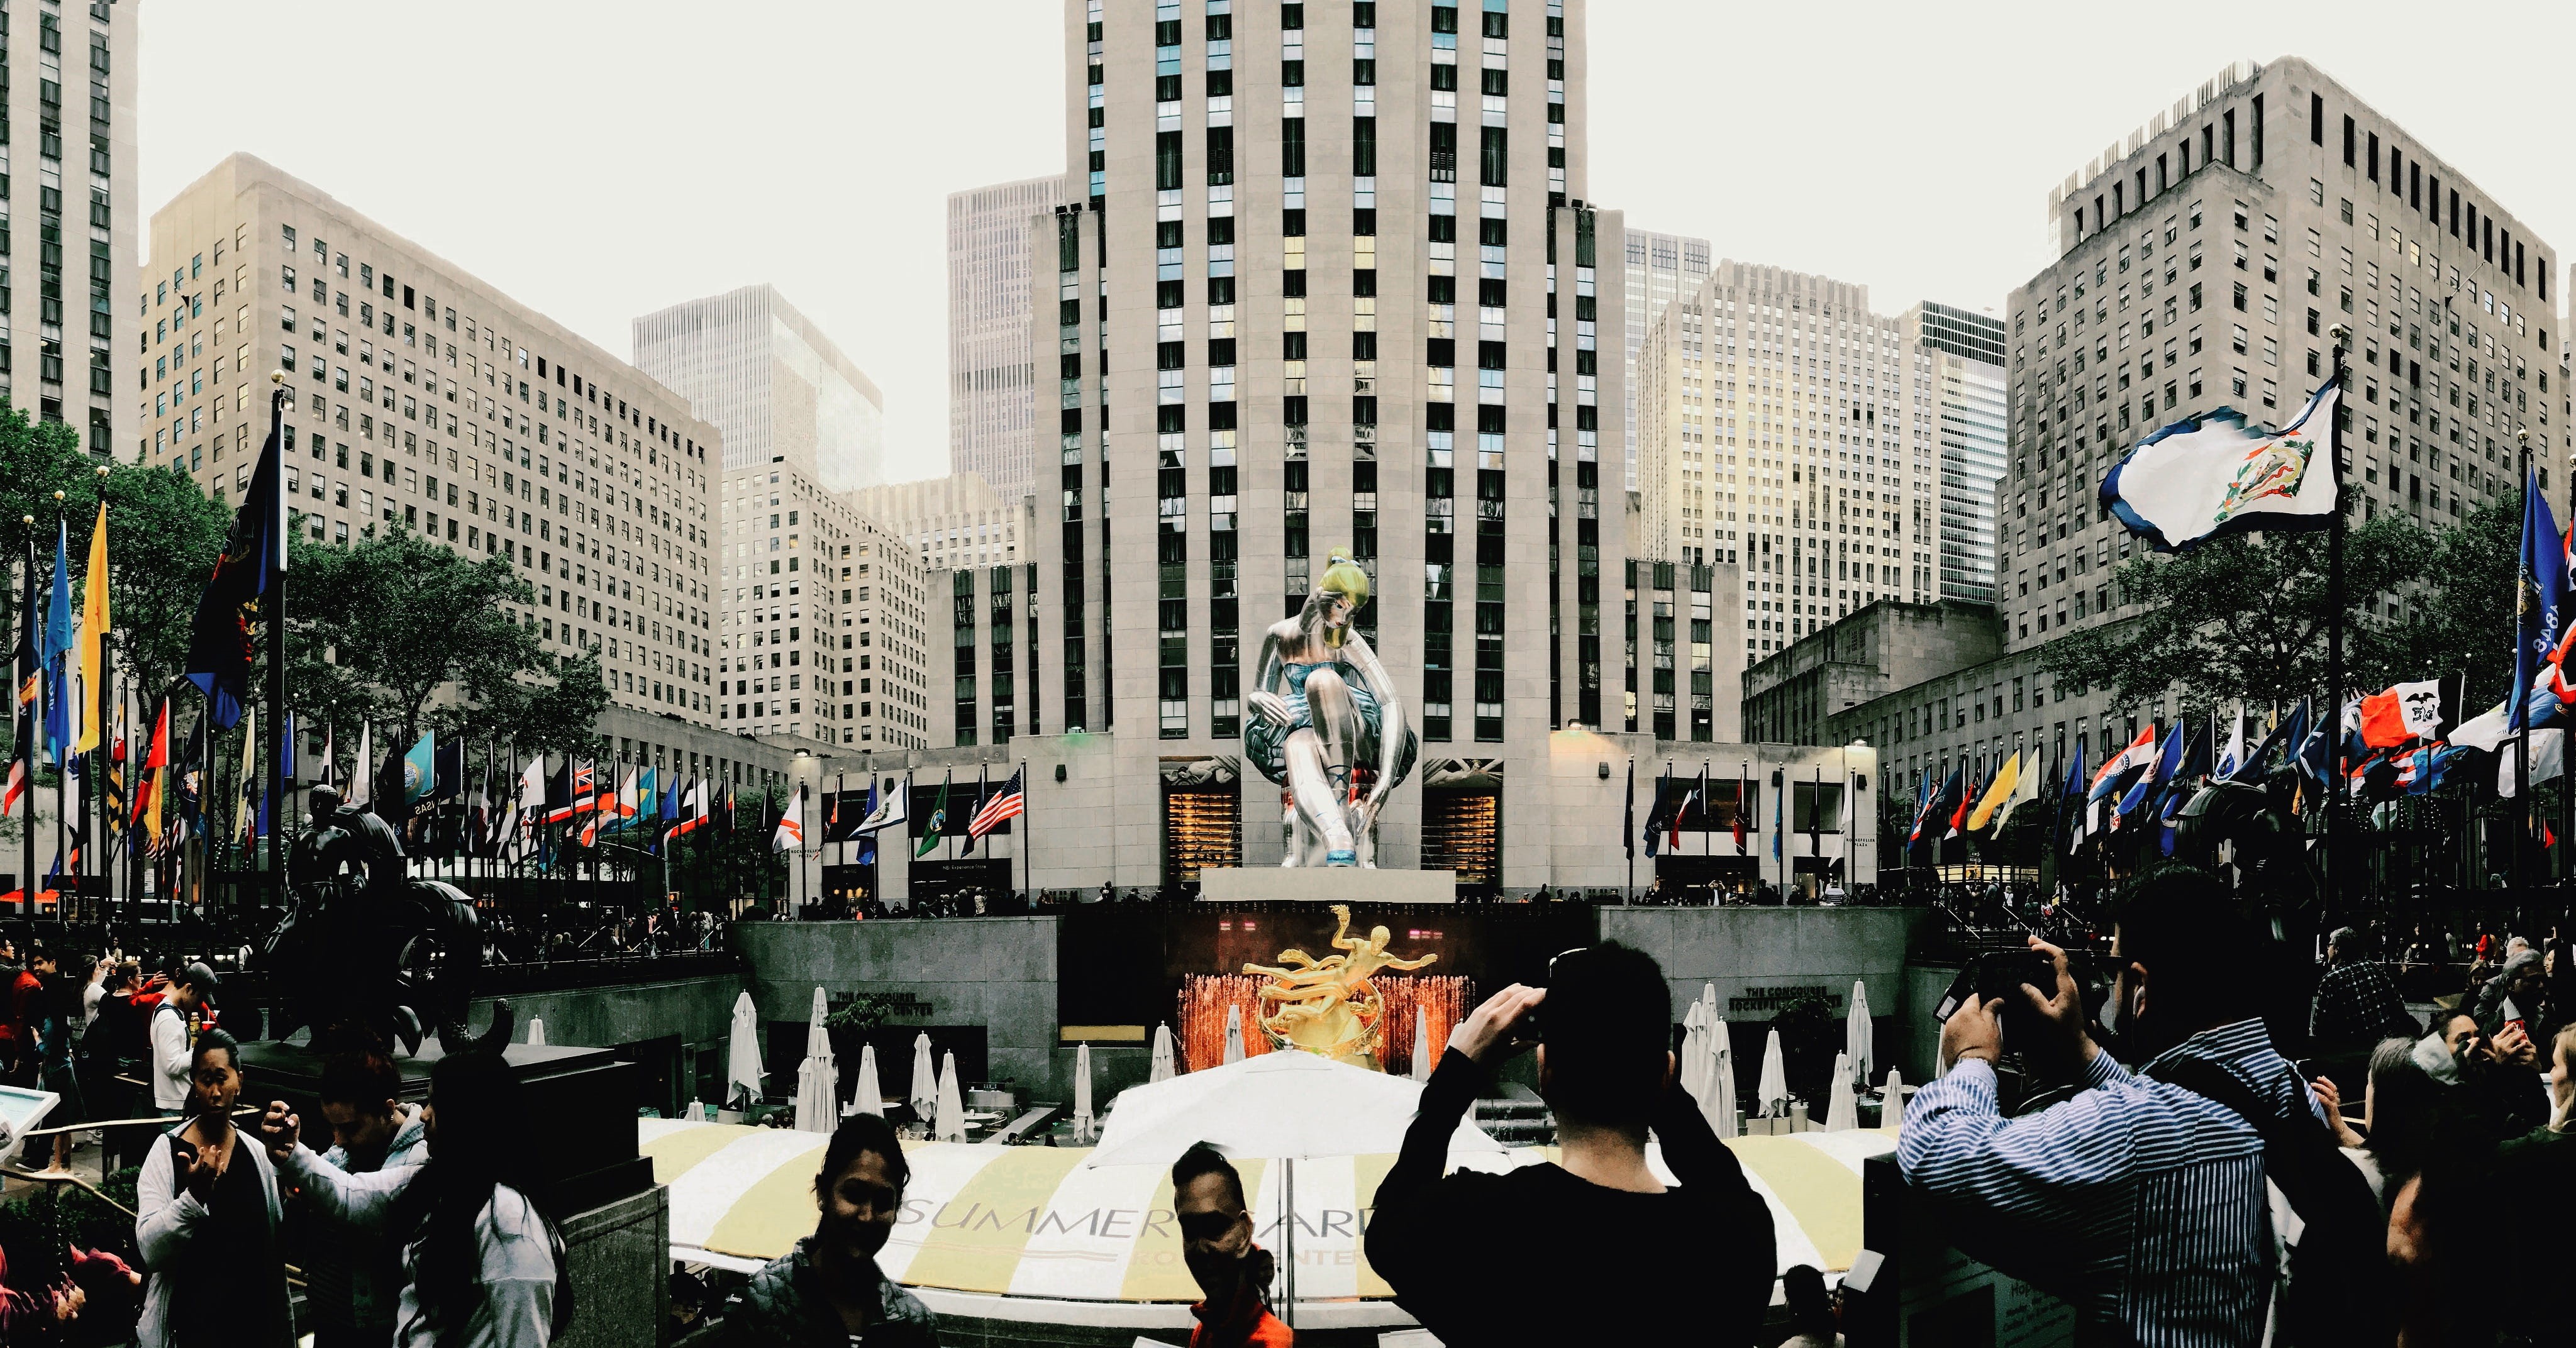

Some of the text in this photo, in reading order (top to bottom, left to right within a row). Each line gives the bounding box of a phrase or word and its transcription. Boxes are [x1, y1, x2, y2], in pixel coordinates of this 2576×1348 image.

[836, 992, 854, 1002] THE
[1746, 986, 1827, 997] THE CONCOURSE
[896, 1198, 1176, 1239] SUMMER
